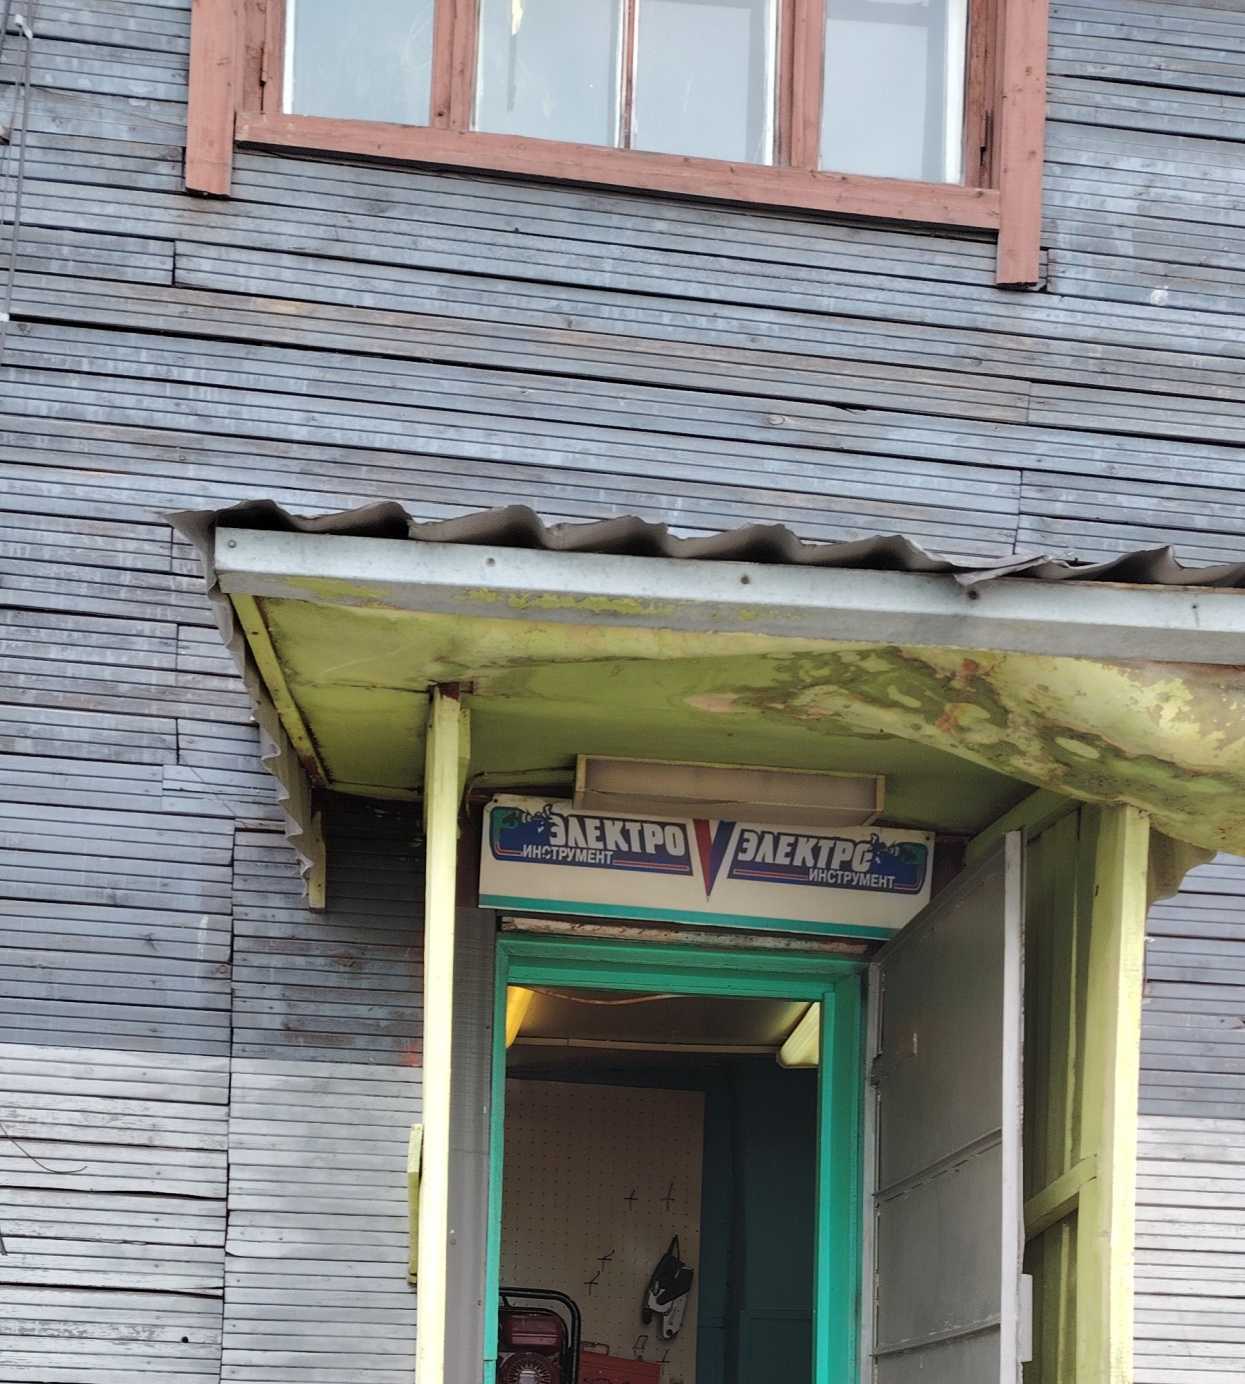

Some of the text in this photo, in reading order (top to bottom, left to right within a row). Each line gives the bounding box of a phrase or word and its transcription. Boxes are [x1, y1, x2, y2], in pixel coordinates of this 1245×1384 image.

[548, 813, 687, 858] ЭЛЕКТРО
[522, 844, 614, 865] ИНСТРУМЕНТ
[808, 869, 896, 889] ИНСТРУМЕНТ
